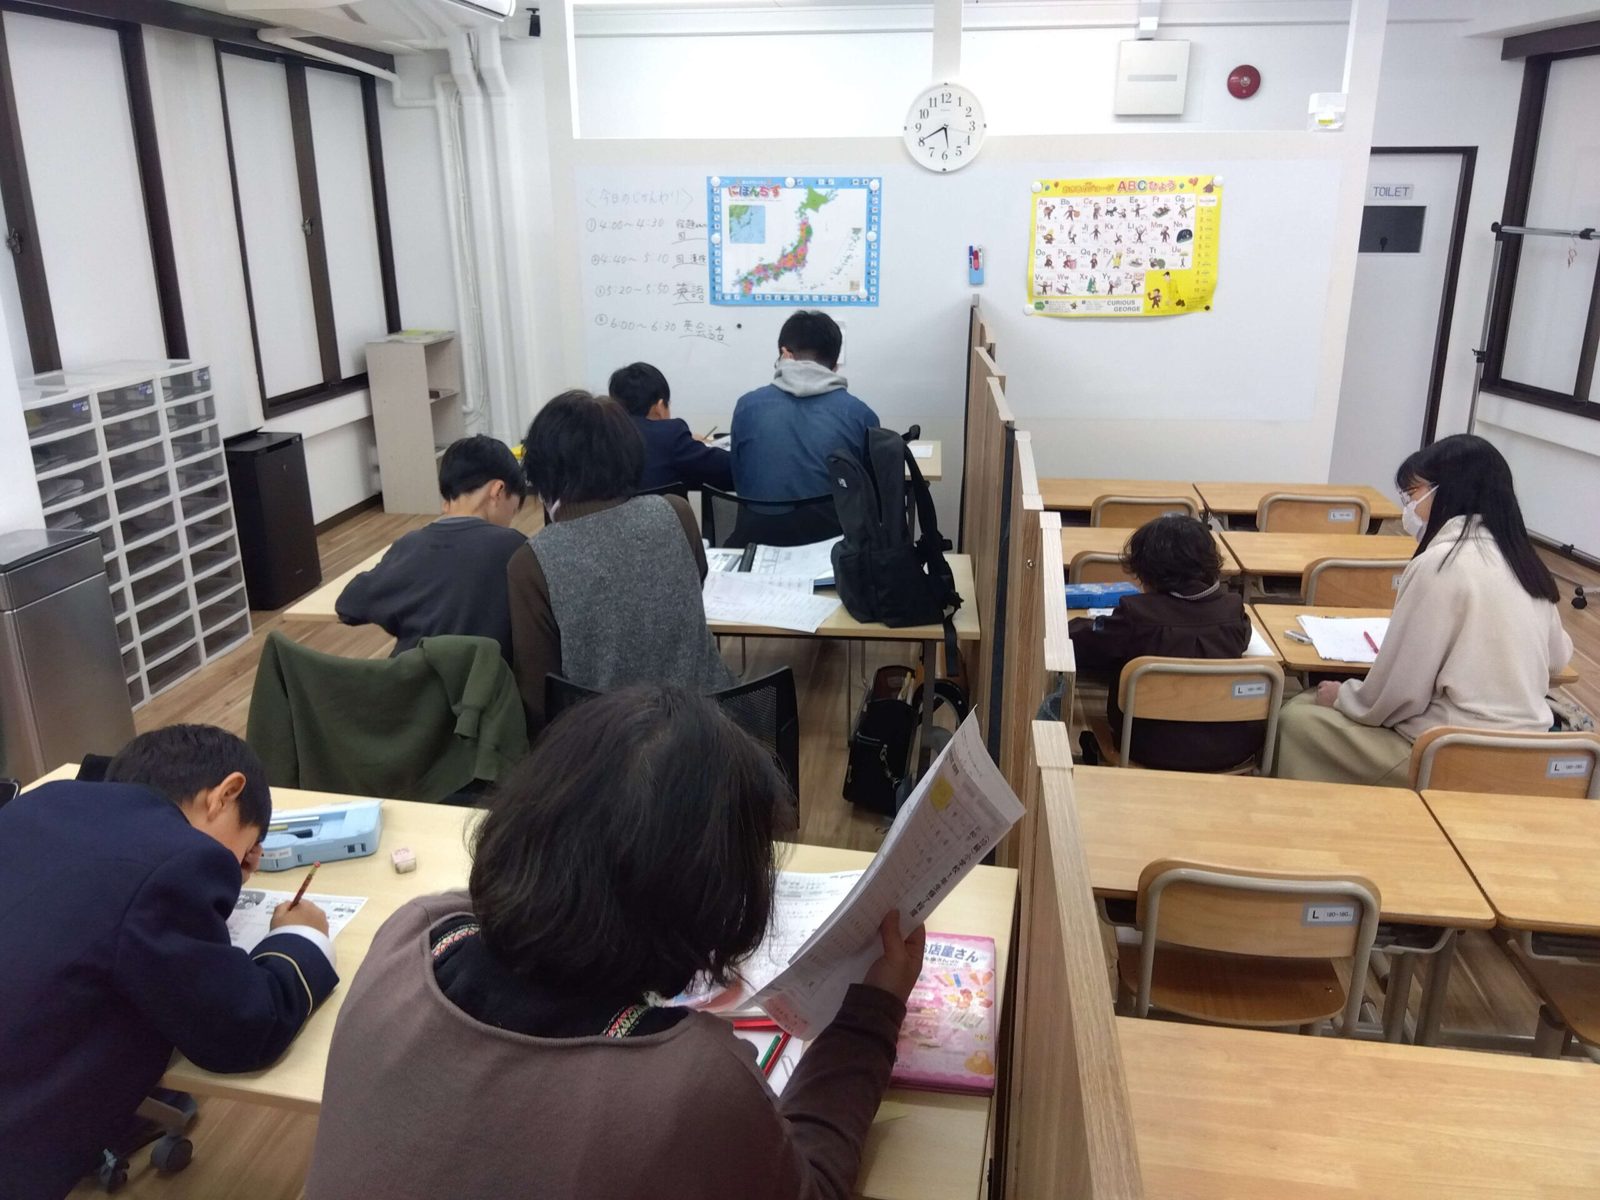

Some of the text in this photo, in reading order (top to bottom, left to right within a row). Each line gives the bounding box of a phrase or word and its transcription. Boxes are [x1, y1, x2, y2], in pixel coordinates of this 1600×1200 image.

[929, 97, 937, 108] 11
[941, 93, 952, 103] 12
[958, 96, 962, 106] 1
[920, 108, 929, 119] 10
[966, 106, 972, 117] 2
[915, 123, 922, 132] 9
[968, 120, 976, 131] 3
[918, 137, 924, 146] 8
[964, 135, 970, 146] 4
[929, 147, 935, 158] 7
[942, 151, 948, 160] 6
[955, 146, 962, 156] 5
[727, 184, 782, 198] にほんちず
[1373, 186, 1410, 197] TOILET
[673, 282, 704, 301] 英語
[684, 320, 724, 341] 英会話
[1312, 910, 1320, 919] L
